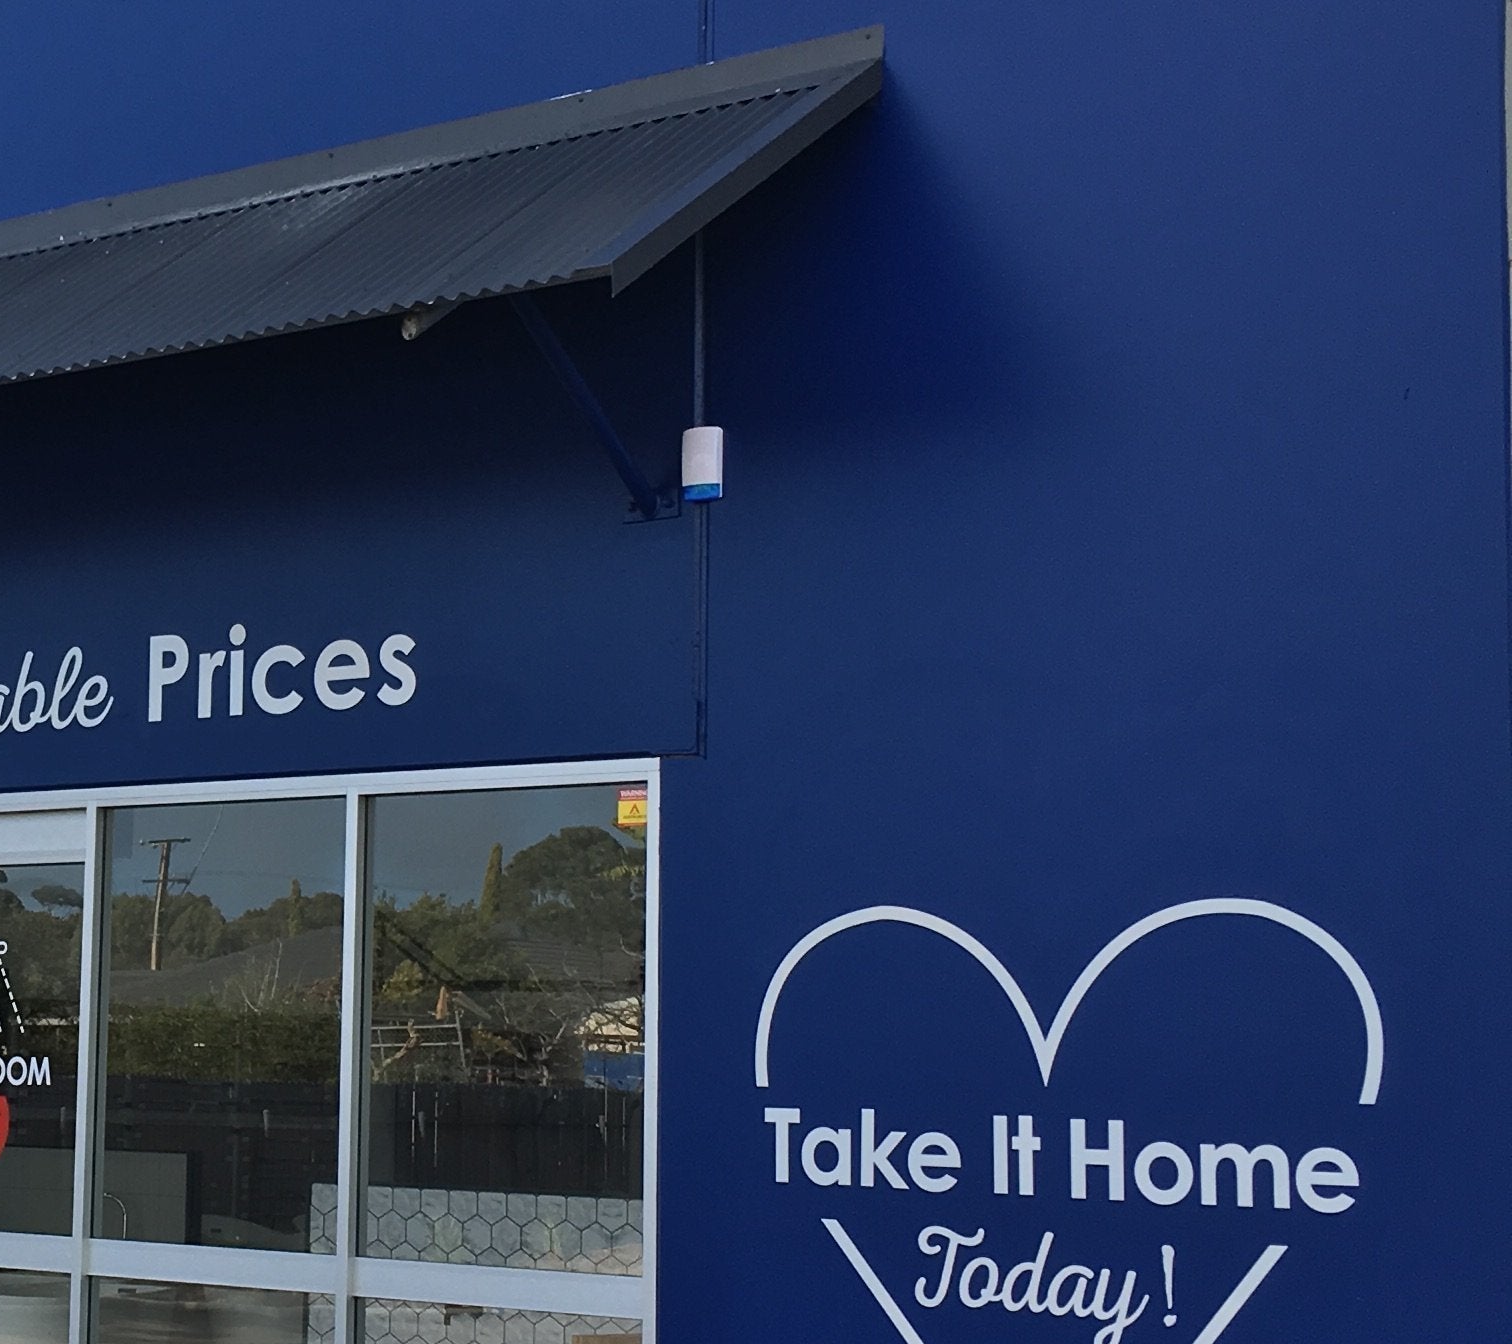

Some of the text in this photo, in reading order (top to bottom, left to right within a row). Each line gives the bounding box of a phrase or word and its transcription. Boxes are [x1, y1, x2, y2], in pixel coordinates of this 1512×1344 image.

[147, 624, 417, 723] Prices
[764, 1107, 1360, 1214] Take It Home
